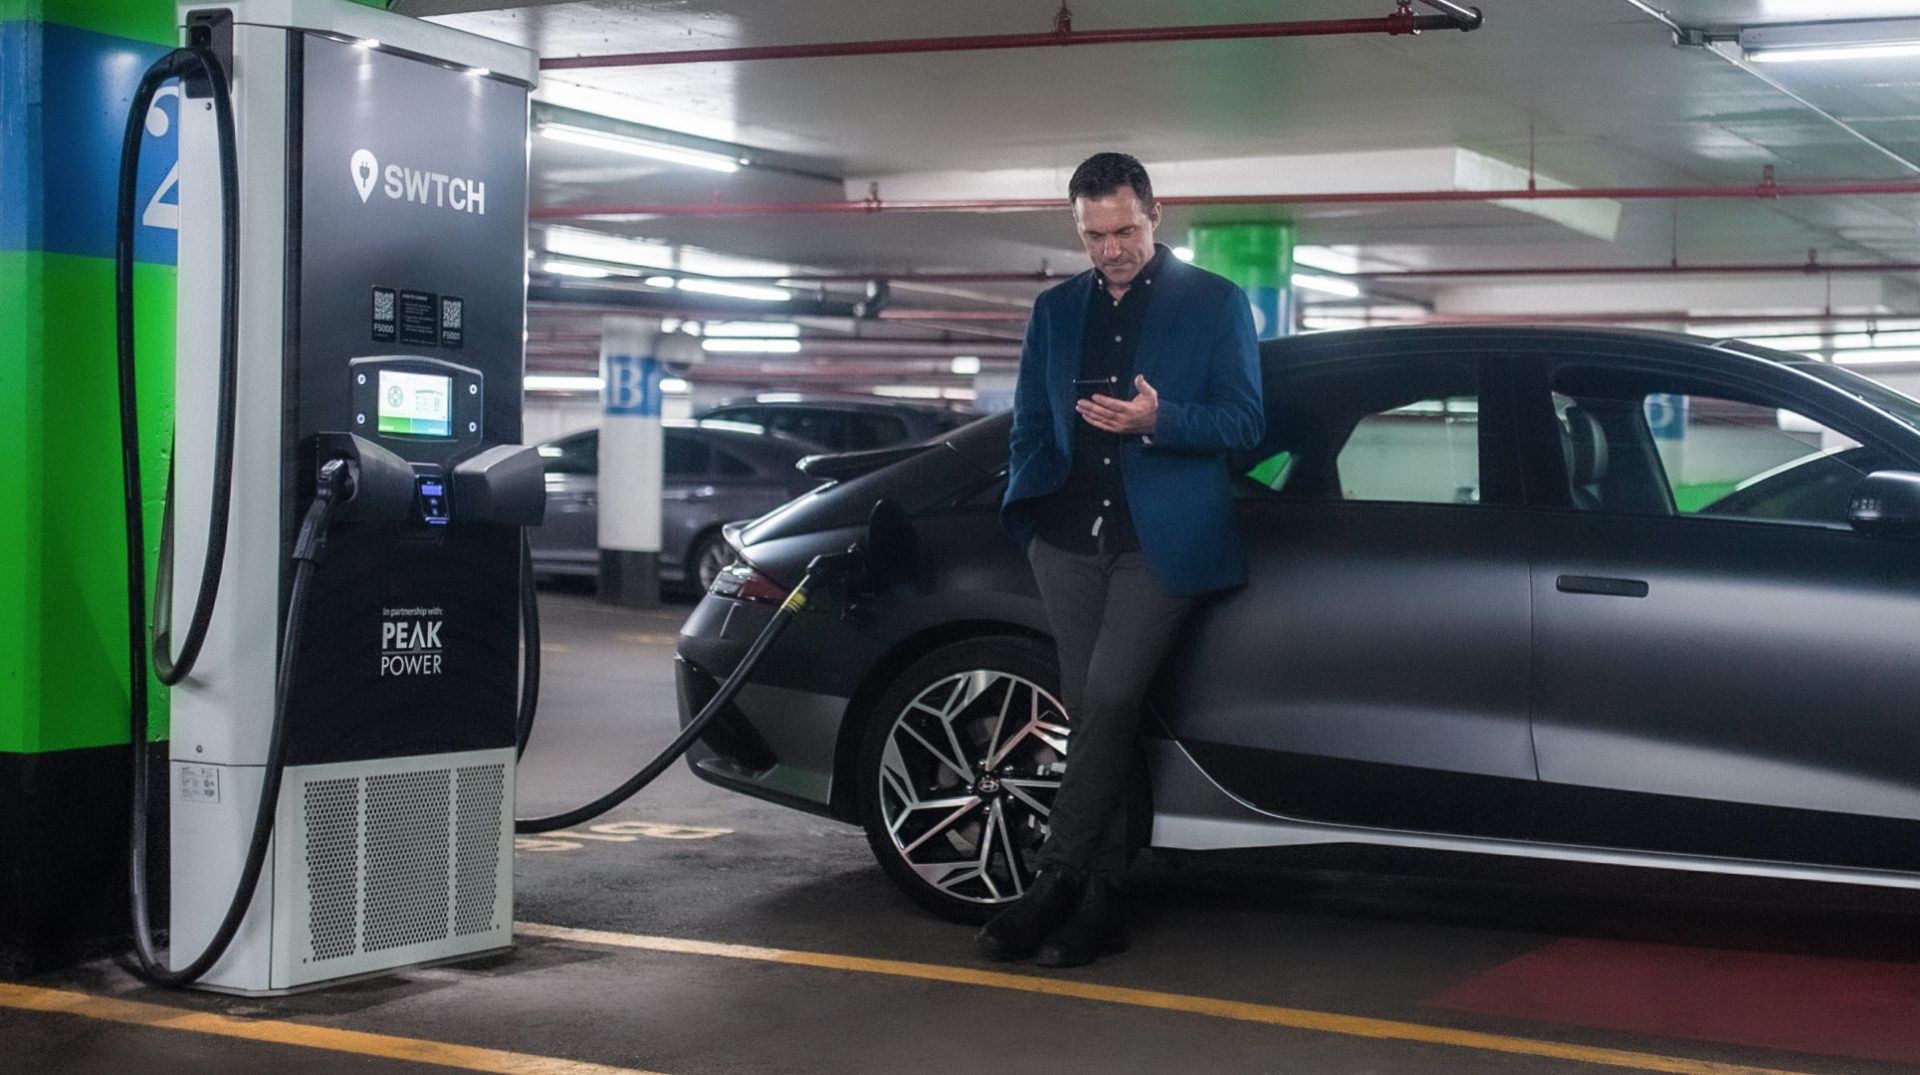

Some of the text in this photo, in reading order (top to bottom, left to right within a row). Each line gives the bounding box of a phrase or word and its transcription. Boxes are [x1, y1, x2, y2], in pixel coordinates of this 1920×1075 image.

[384, 164, 485, 215] SWTCH
[373, 322, 395, 335] F5000
[611, 363, 643, 409] B
[382, 606, 390, 616] In
[390, 606, 427, 618] partnership
[382, 620, 443, 650] PEAK
[381, 654, 443, 676] POWER
